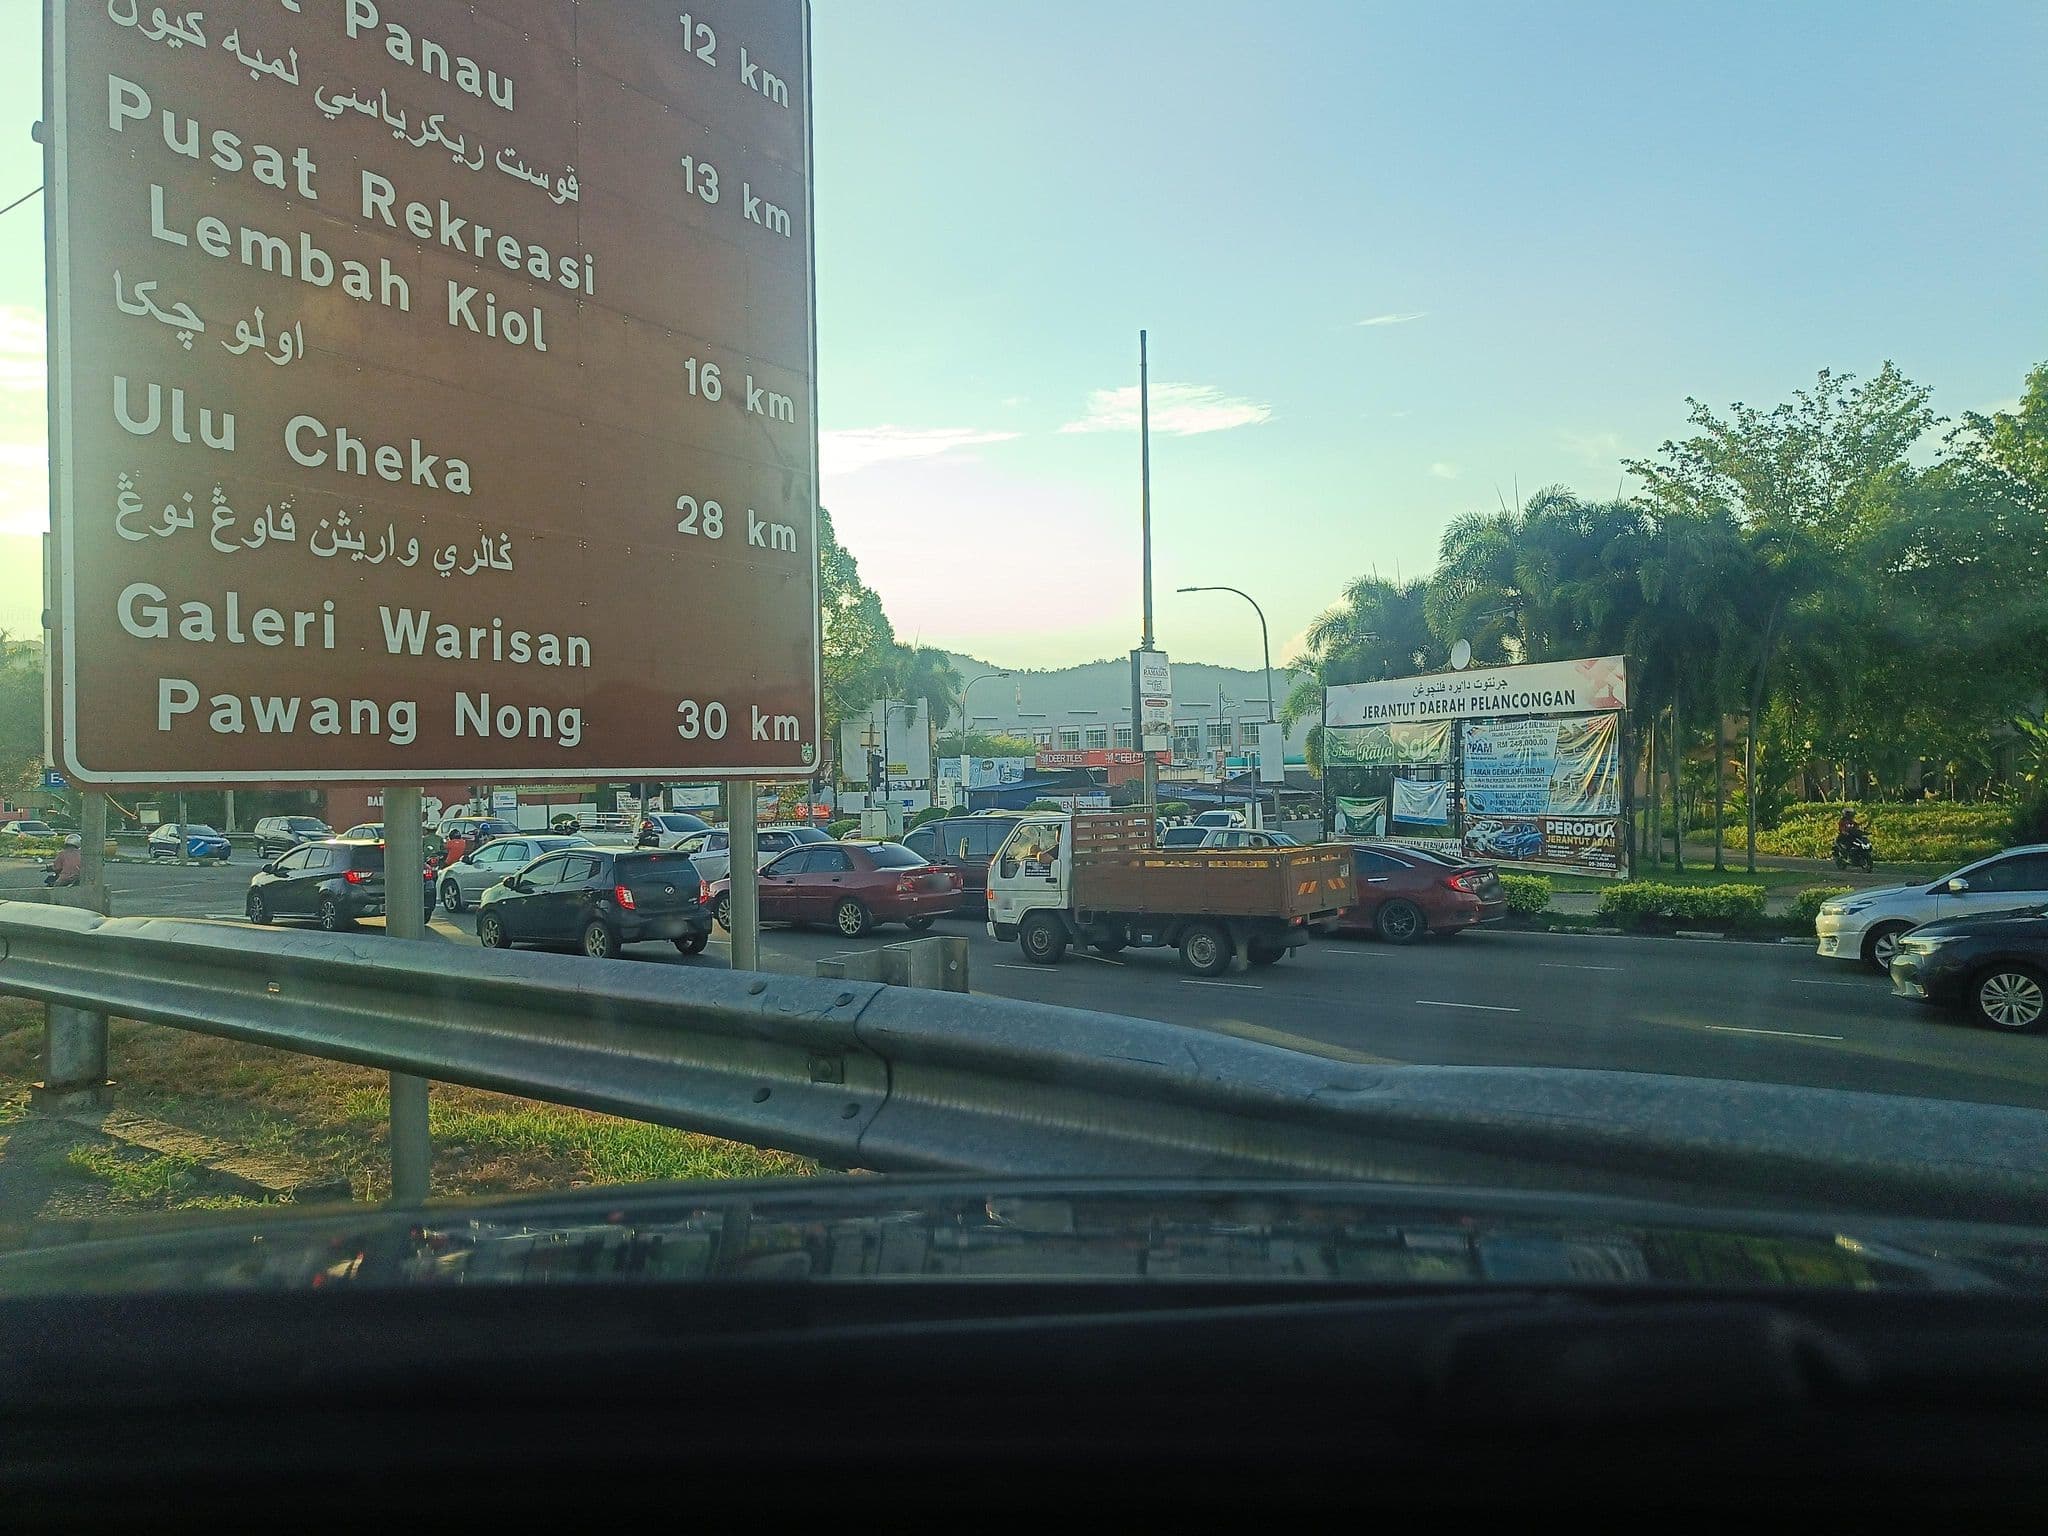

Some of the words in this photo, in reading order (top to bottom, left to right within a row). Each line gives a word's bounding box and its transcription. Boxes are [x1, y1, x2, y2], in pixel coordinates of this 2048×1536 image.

[346, 0, 514, 112] Panau
[679, 12, 717, 68] 12
[740, 46, 789, 109] km
[108, 74, 318, 200] Pusat
[361, 169, 594, 296] Rekreasi
[681, 155, 719, 204] 13
[743, 182, 791, 238] km
[150, 183, 410, 312] Lembah
[447, 279, 548, 352] Kiol
[684, 357, 722, 402] 16
[746, 374, 795, 424] km
[113, 375, 236, 453] Ulu
[284, 415, 472, 496] Cheka
[676, 495, 724, 540] 28
[747, 508, 797, 557] km
[117, 582, 335, 650] Galeri
[378, 605, 591, 668] Warisan
[158, 678, 417, 745] Pawang
[455, 691, 582, 748] Nong
[677, 699, 728, 740] 30
[751, 704, 800, 742] km
[1362, 702, 1416, 719] JERANTUT
[1419, 697, 1466, 715] DAERAH
[1471, 689, 1576, 711] PELANCONGAN
[1049, 754, 1065, 763] DEER
[1546, 821, 1616, 838] PERODUA
[1546, 835, 1590, 846] JERANTUT
